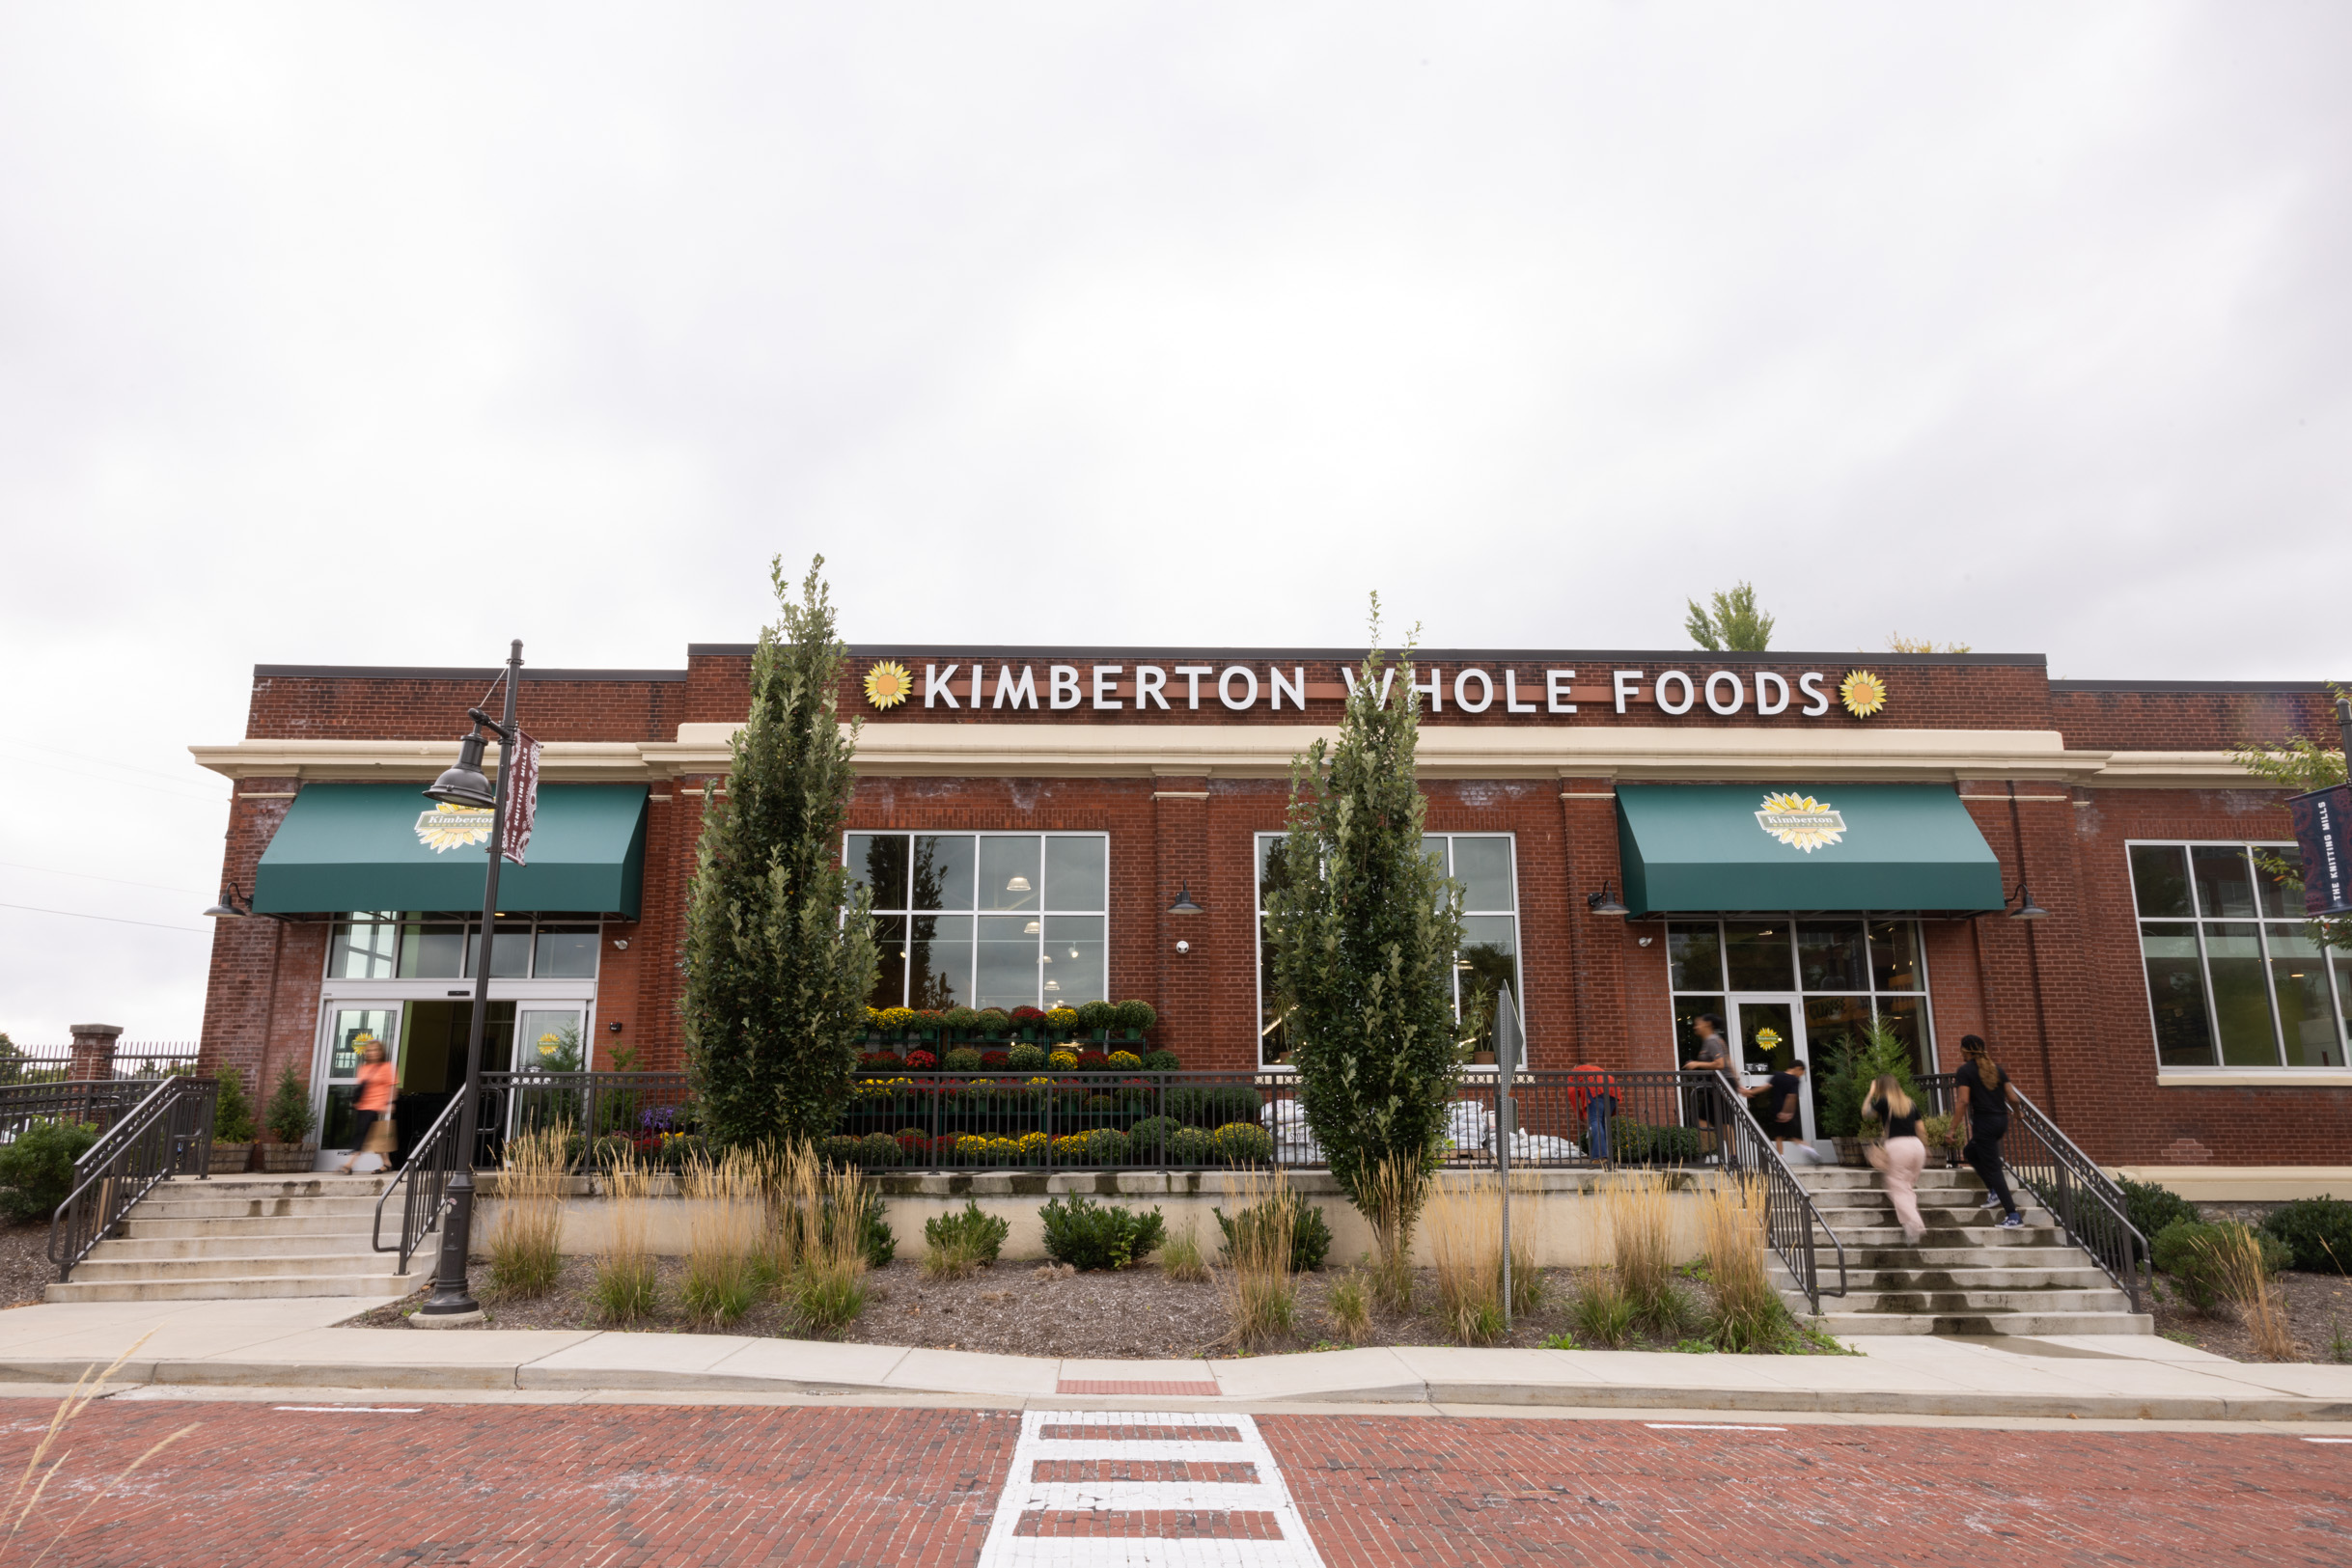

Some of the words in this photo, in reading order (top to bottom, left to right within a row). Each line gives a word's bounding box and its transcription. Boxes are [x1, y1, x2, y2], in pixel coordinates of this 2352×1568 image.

[925, 664, 1305, 710] KIMBERTON
[1342, 667, 1577, 713] WHOLE
[1614, 670, 1829, 716] FOODS
[514, 781, 525, 827] KNITTING
[2318, 801, 2330, 830] MILLS
[2324, 834, 2338, 878] KNITTING
[2331, 882, 2341, 901] THE
